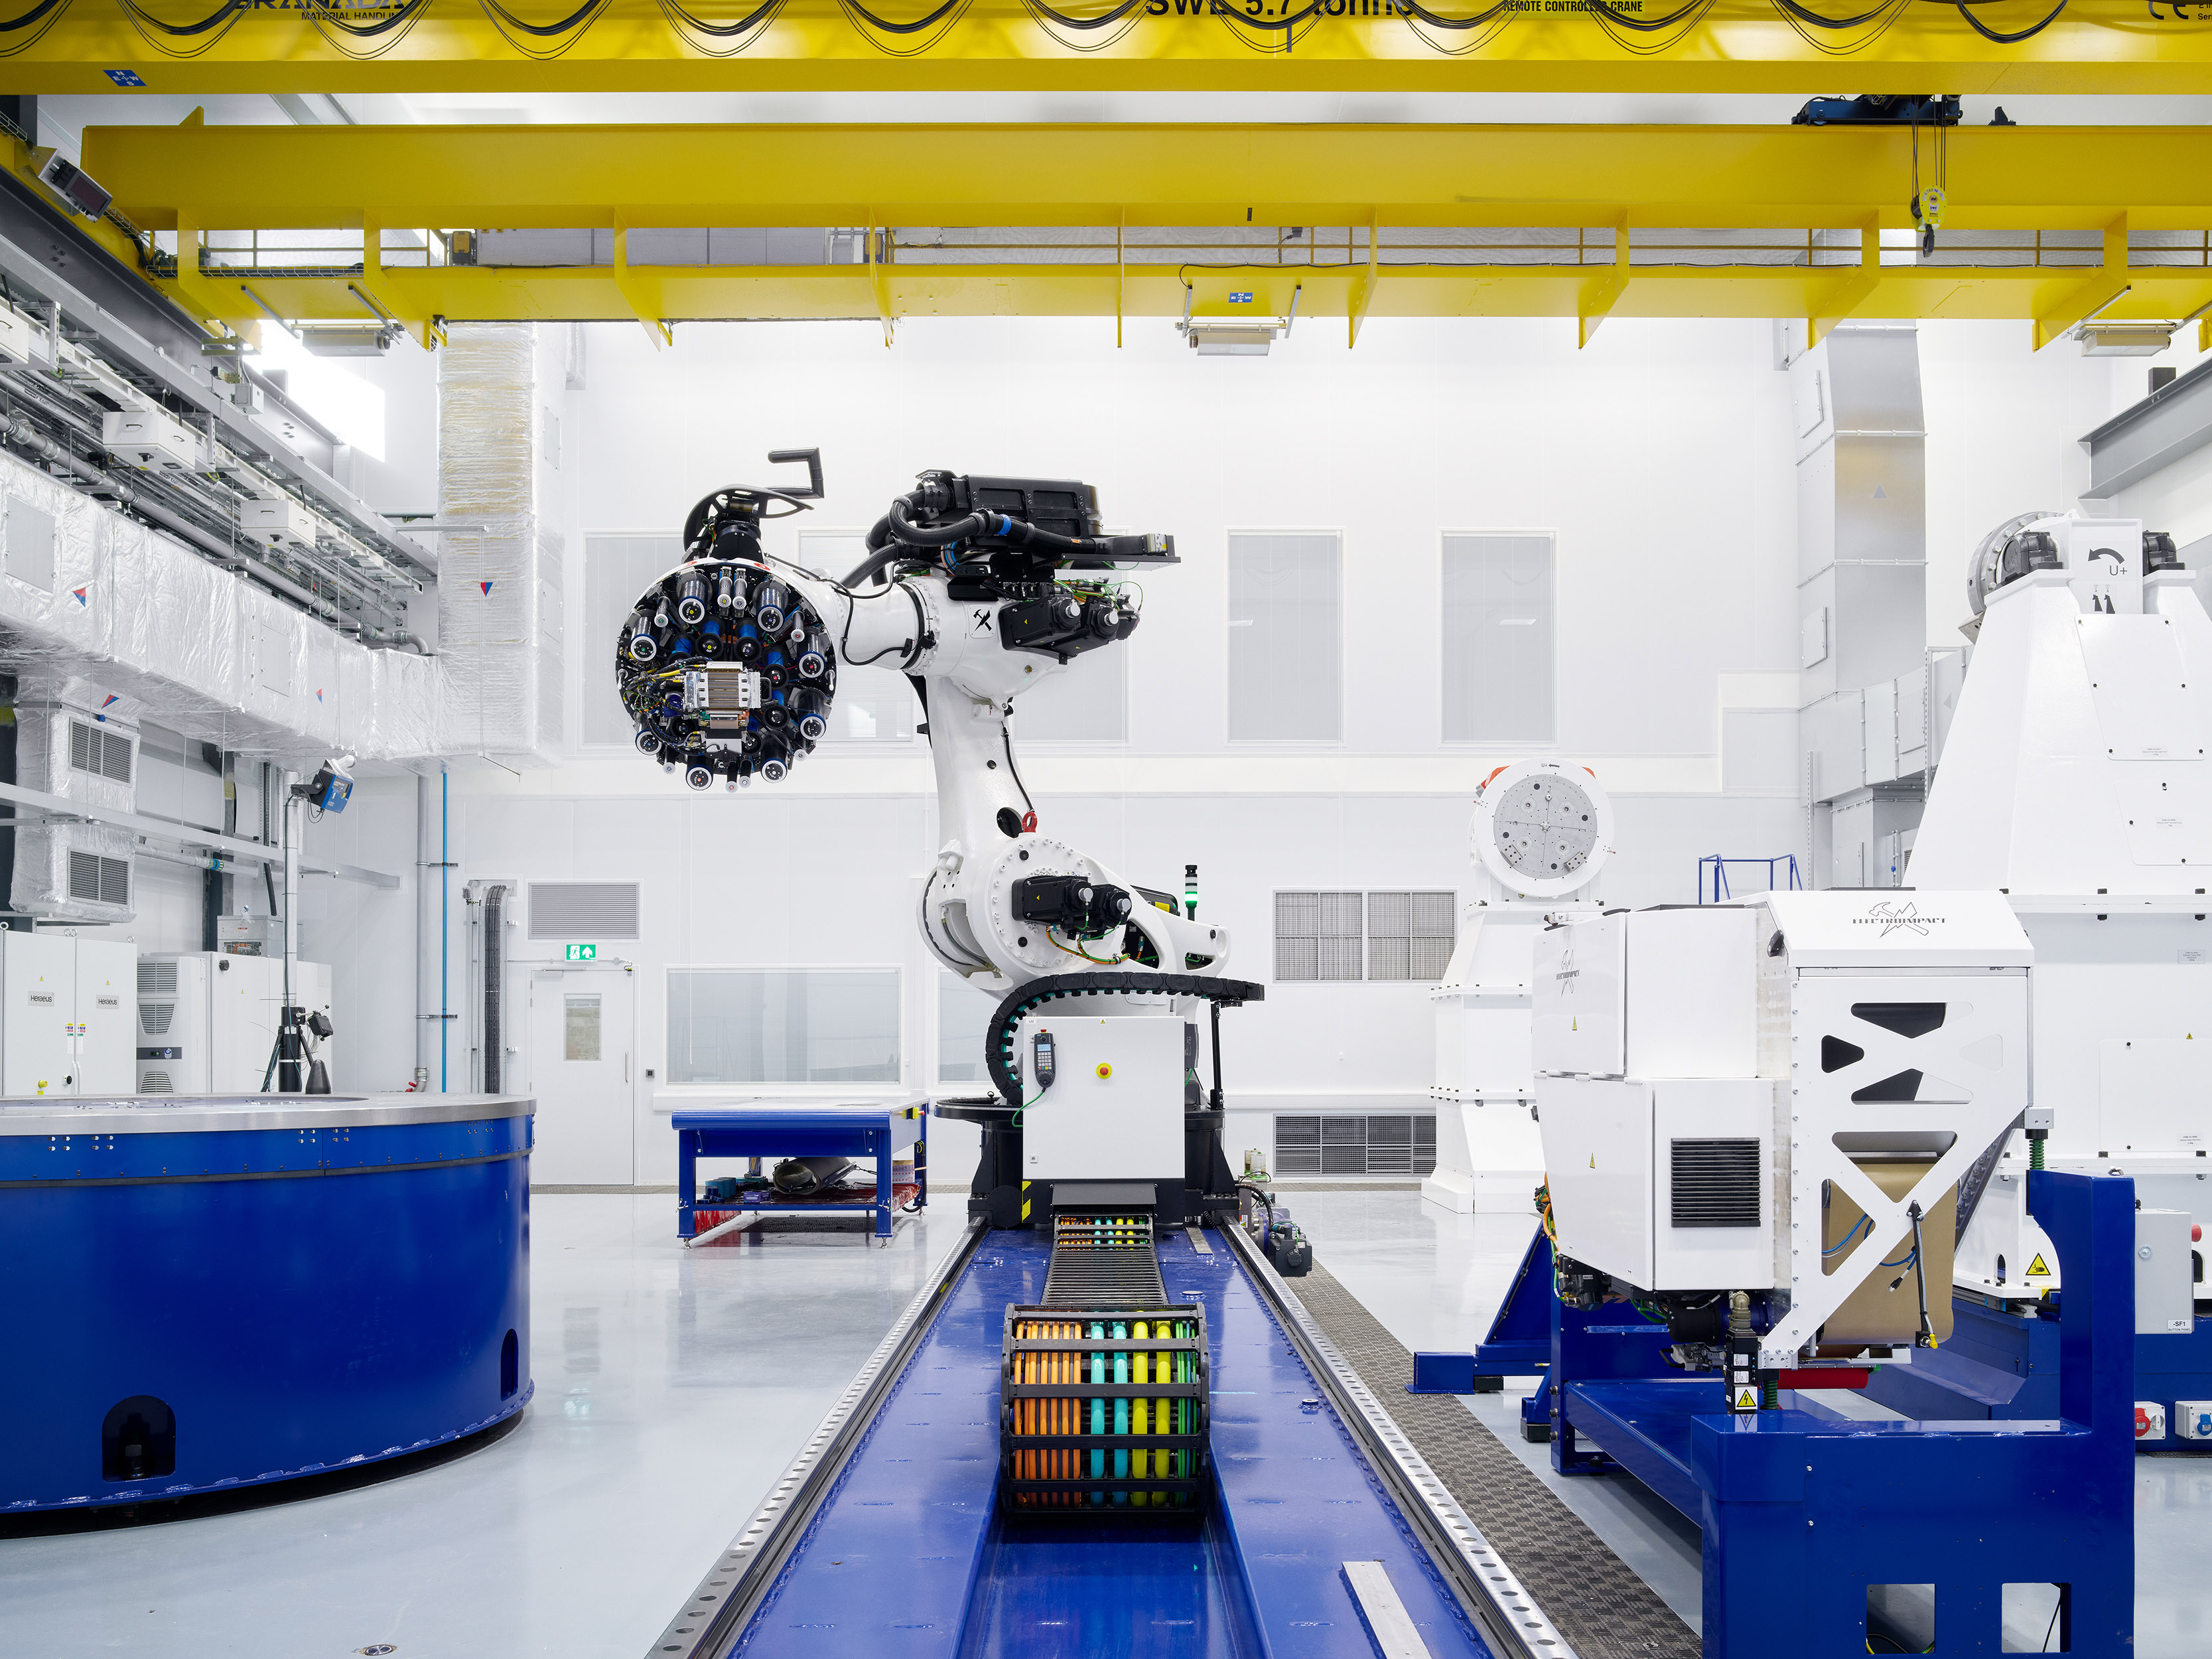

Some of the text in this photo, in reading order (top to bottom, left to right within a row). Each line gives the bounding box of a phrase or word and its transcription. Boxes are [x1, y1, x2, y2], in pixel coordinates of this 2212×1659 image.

[1503, 1, 1541, 12] REMOTE
[1610, 1, 1643, 12] CRANE
[2110, 565, 2127, 576] U+
